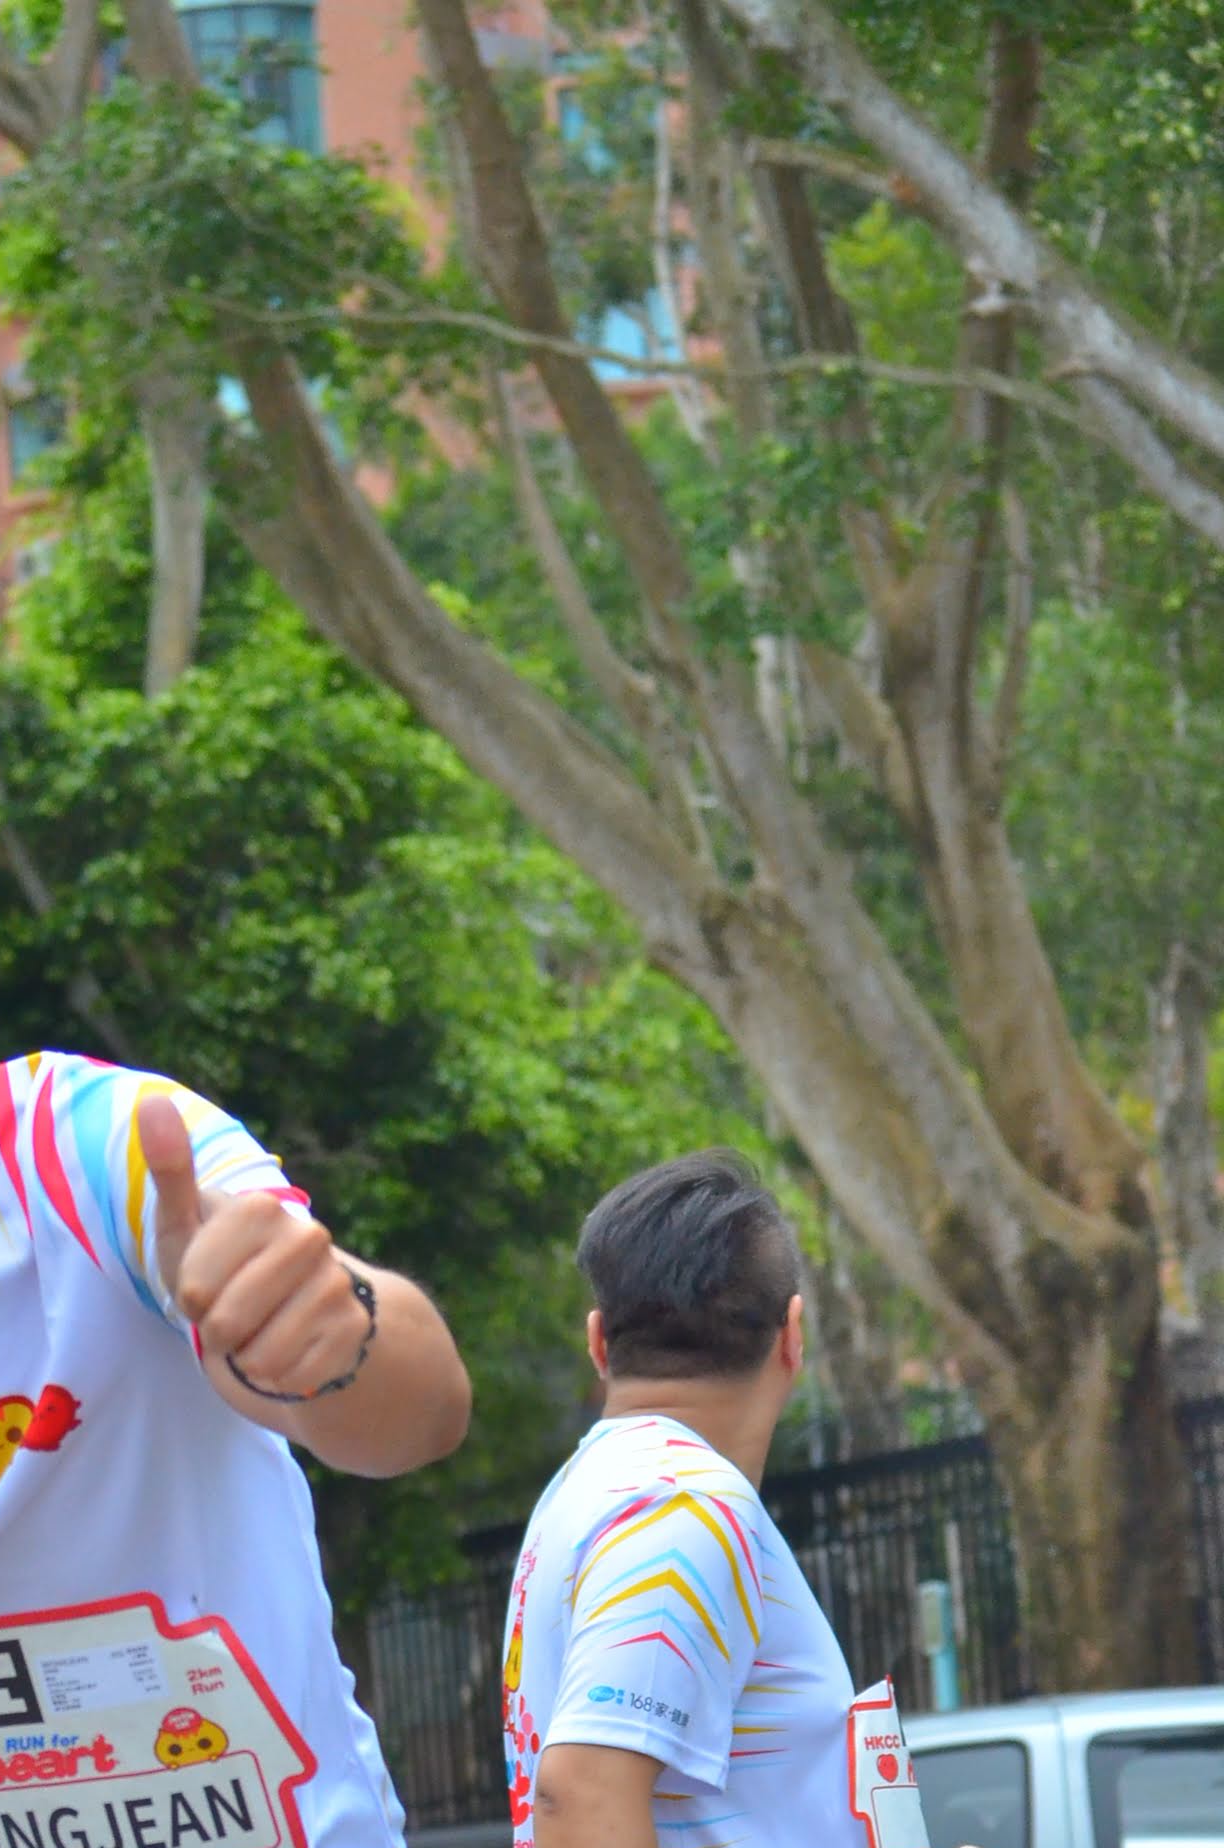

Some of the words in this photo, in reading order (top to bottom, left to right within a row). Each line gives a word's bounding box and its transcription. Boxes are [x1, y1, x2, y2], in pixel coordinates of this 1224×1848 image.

[185, 1665, 223, 1683] 2km
[190, 1681, 225, 1696] Run
[4, 1734, 46, 1753] RUN
[50, 1732, 80, 1748] for
[864, 1734, 901, 1751] HKCC
